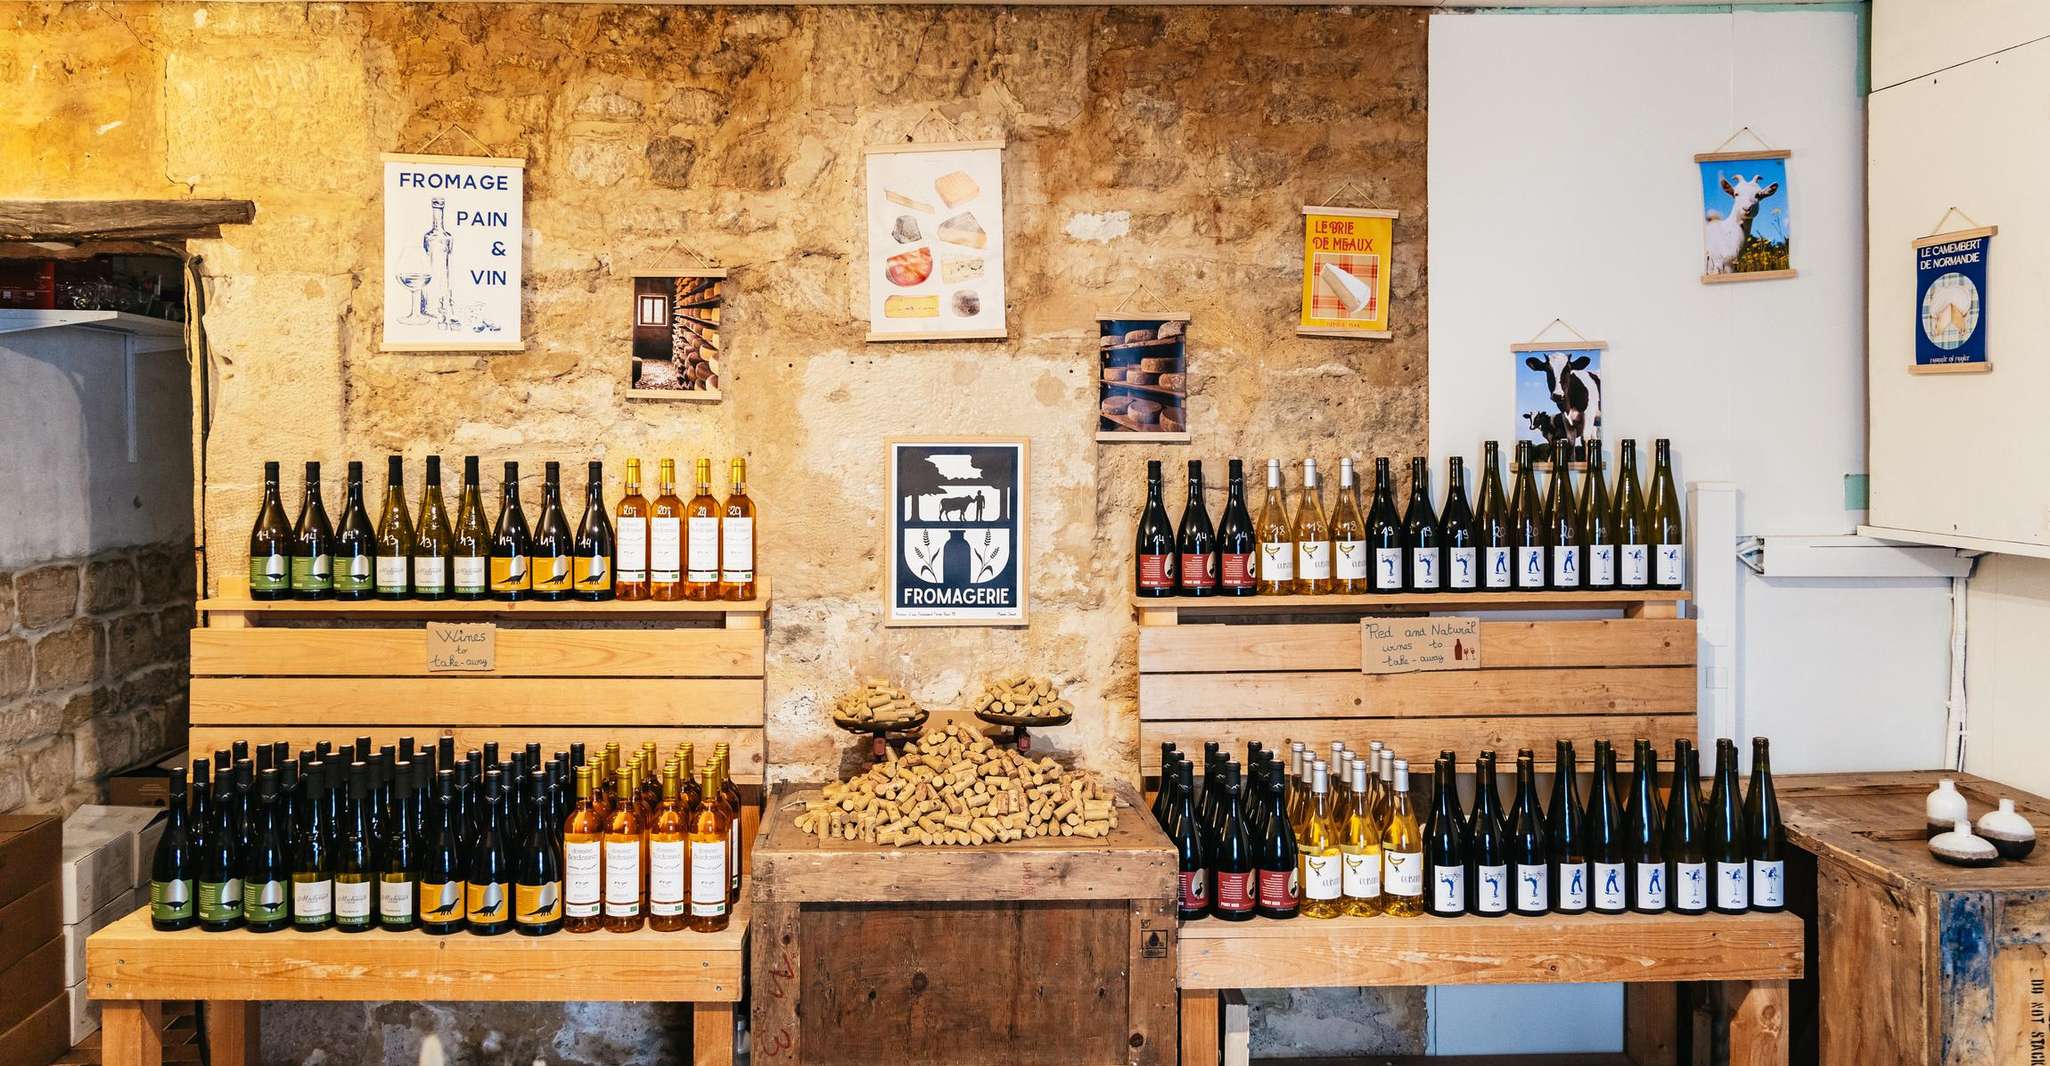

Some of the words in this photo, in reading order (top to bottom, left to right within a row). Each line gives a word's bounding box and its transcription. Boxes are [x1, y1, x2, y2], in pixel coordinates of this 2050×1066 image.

[399, 172, 508, 190] FROMAGE
[456, 211, 507, 227] PAIN
[1315, 220, 1328, 234] LE
[1329, 220, 1354, 235] BRIE
[491, 241, 507, 257] &
[1312, 236, 1329, 250] DE
[1333, 238, 1374, 252] MEAUX
[1921, 247, 1931, 258] LE
[1932, 238, 1982, 257] CAMEMBERT
[1920, 258, 1932, 270] DE
[1932, 251, 1981, 269] NORMANDIE
[470, 269, 507, 286] VIN
[904, 588, 1009, 605] FROMAGERIE
[435, 629, 486, 642] Wines
[1366, 623, 1393, 639] Red
[1404, 627, 1426, 637] and
[1431, 621, 1476, 635] Natural
[456, 645, 467, 655] to
[1382, 642, 1413, 652] wines
[1428, 639, 1443, 649] to
[430, 654, 488, 667] take-away
[2031, 979, 2045, 994] DO
[2031, 1002, 2045, 1024] NOT
